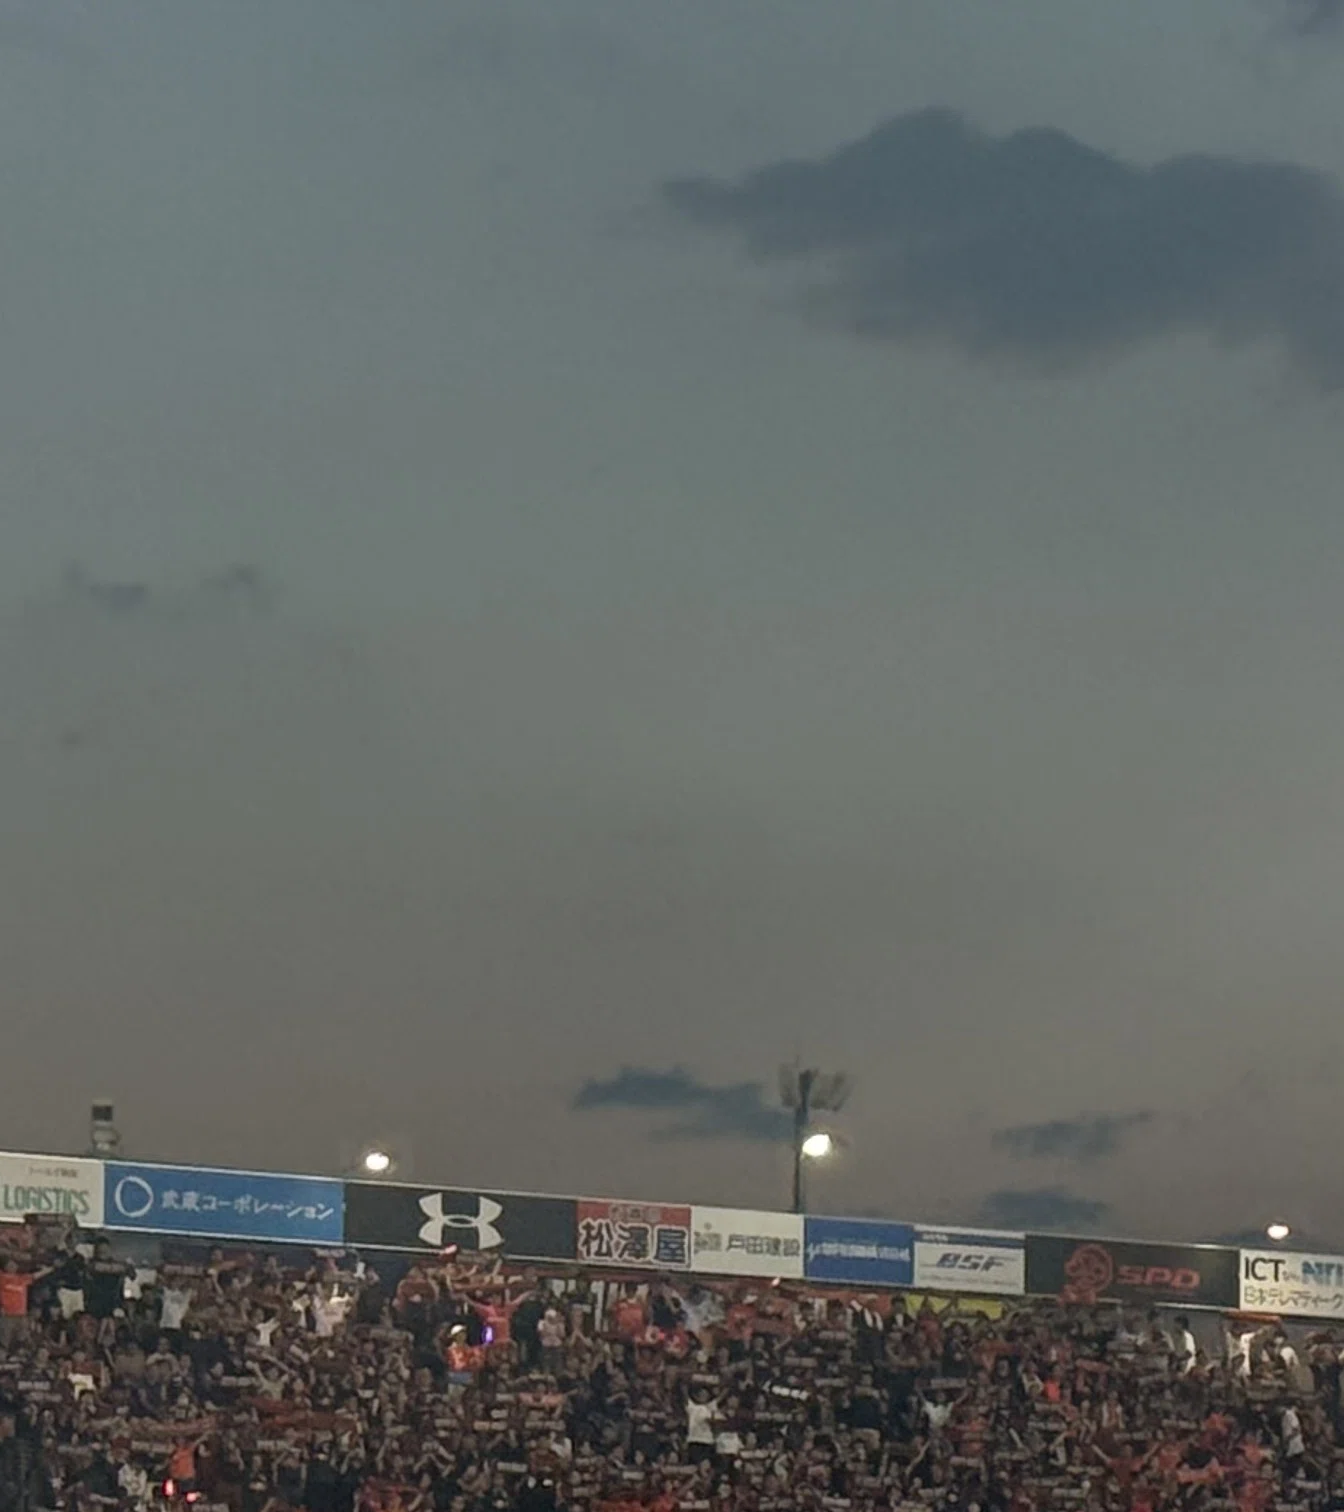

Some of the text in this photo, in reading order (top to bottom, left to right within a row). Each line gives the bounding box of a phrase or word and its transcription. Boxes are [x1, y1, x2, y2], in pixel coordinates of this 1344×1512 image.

[4, 1184, 90, 1215] LOGISTICS
[1116, 1265, 1201, 1289] SPD
[1244, 1256, 1286, 1282] ICT
